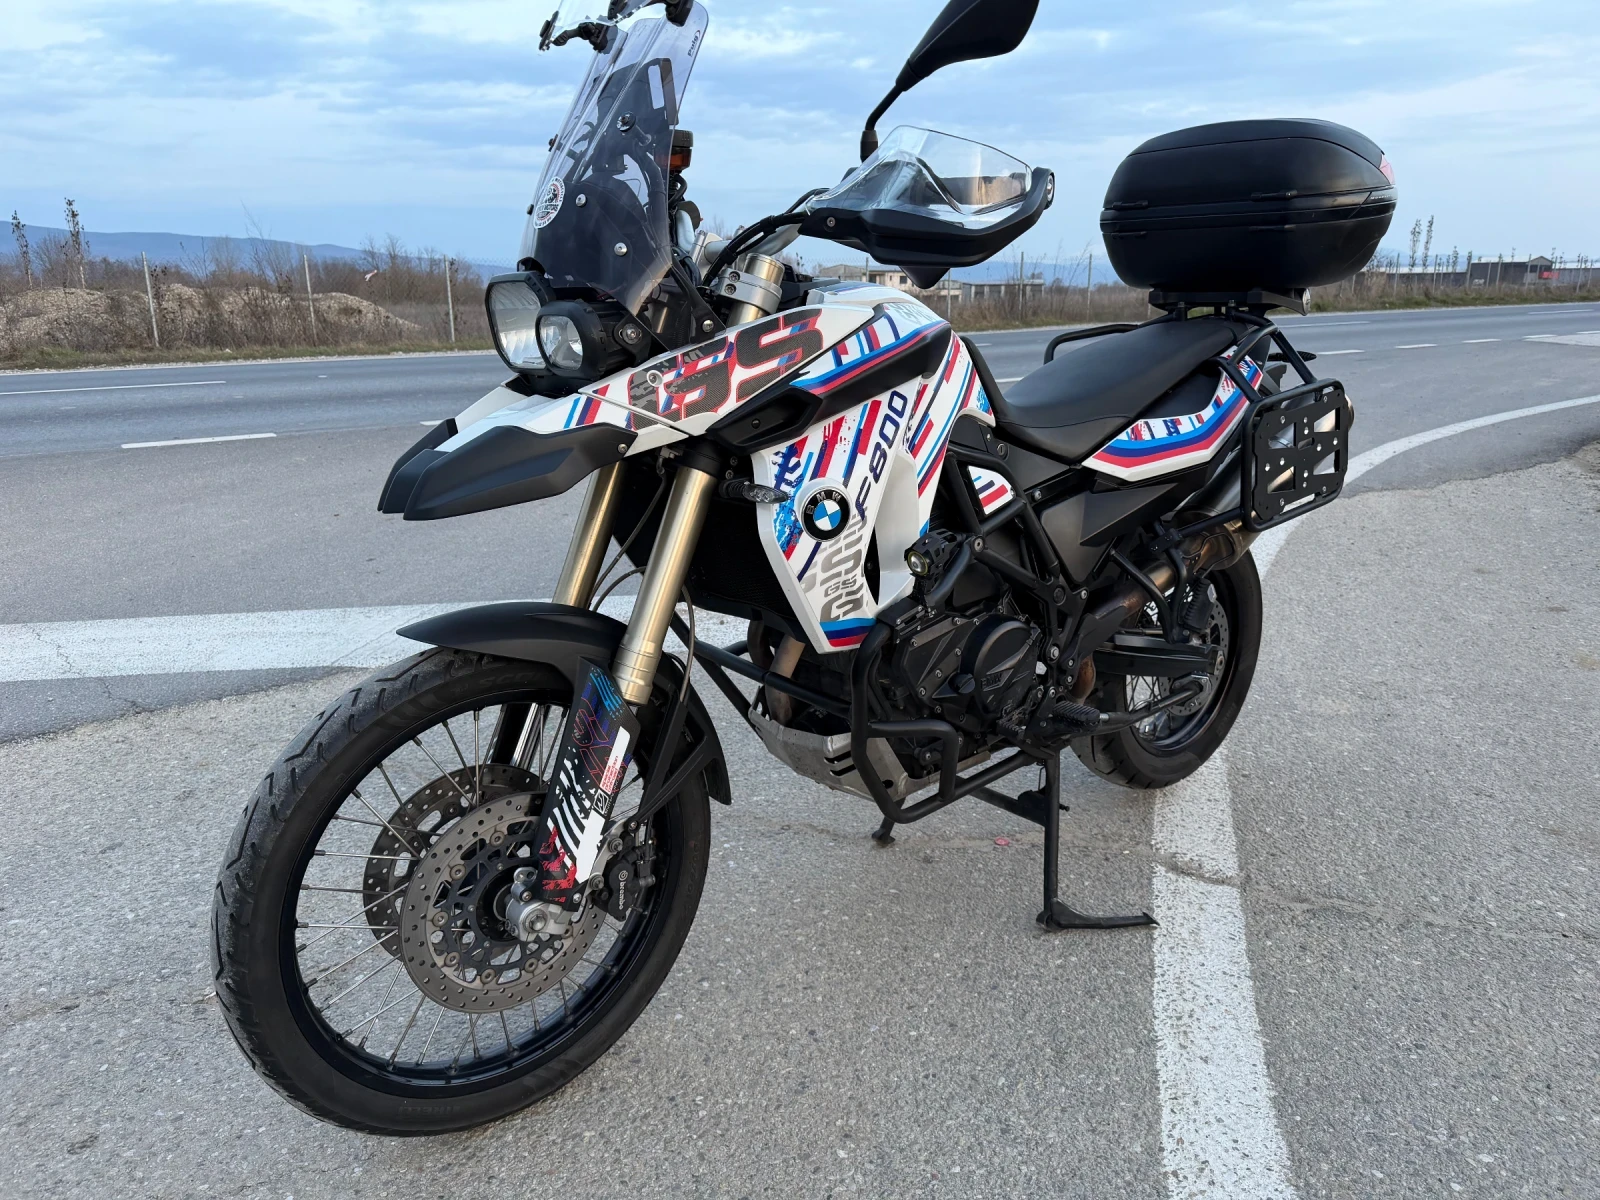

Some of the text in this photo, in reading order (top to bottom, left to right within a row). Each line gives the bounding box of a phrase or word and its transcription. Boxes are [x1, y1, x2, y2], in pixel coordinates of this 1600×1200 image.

[628, 308, 824, 430] GS
[806, 491, 842, 515] BMW
[824, 575, 858, 598] GS
[619, 881, 627, 910] brembo
